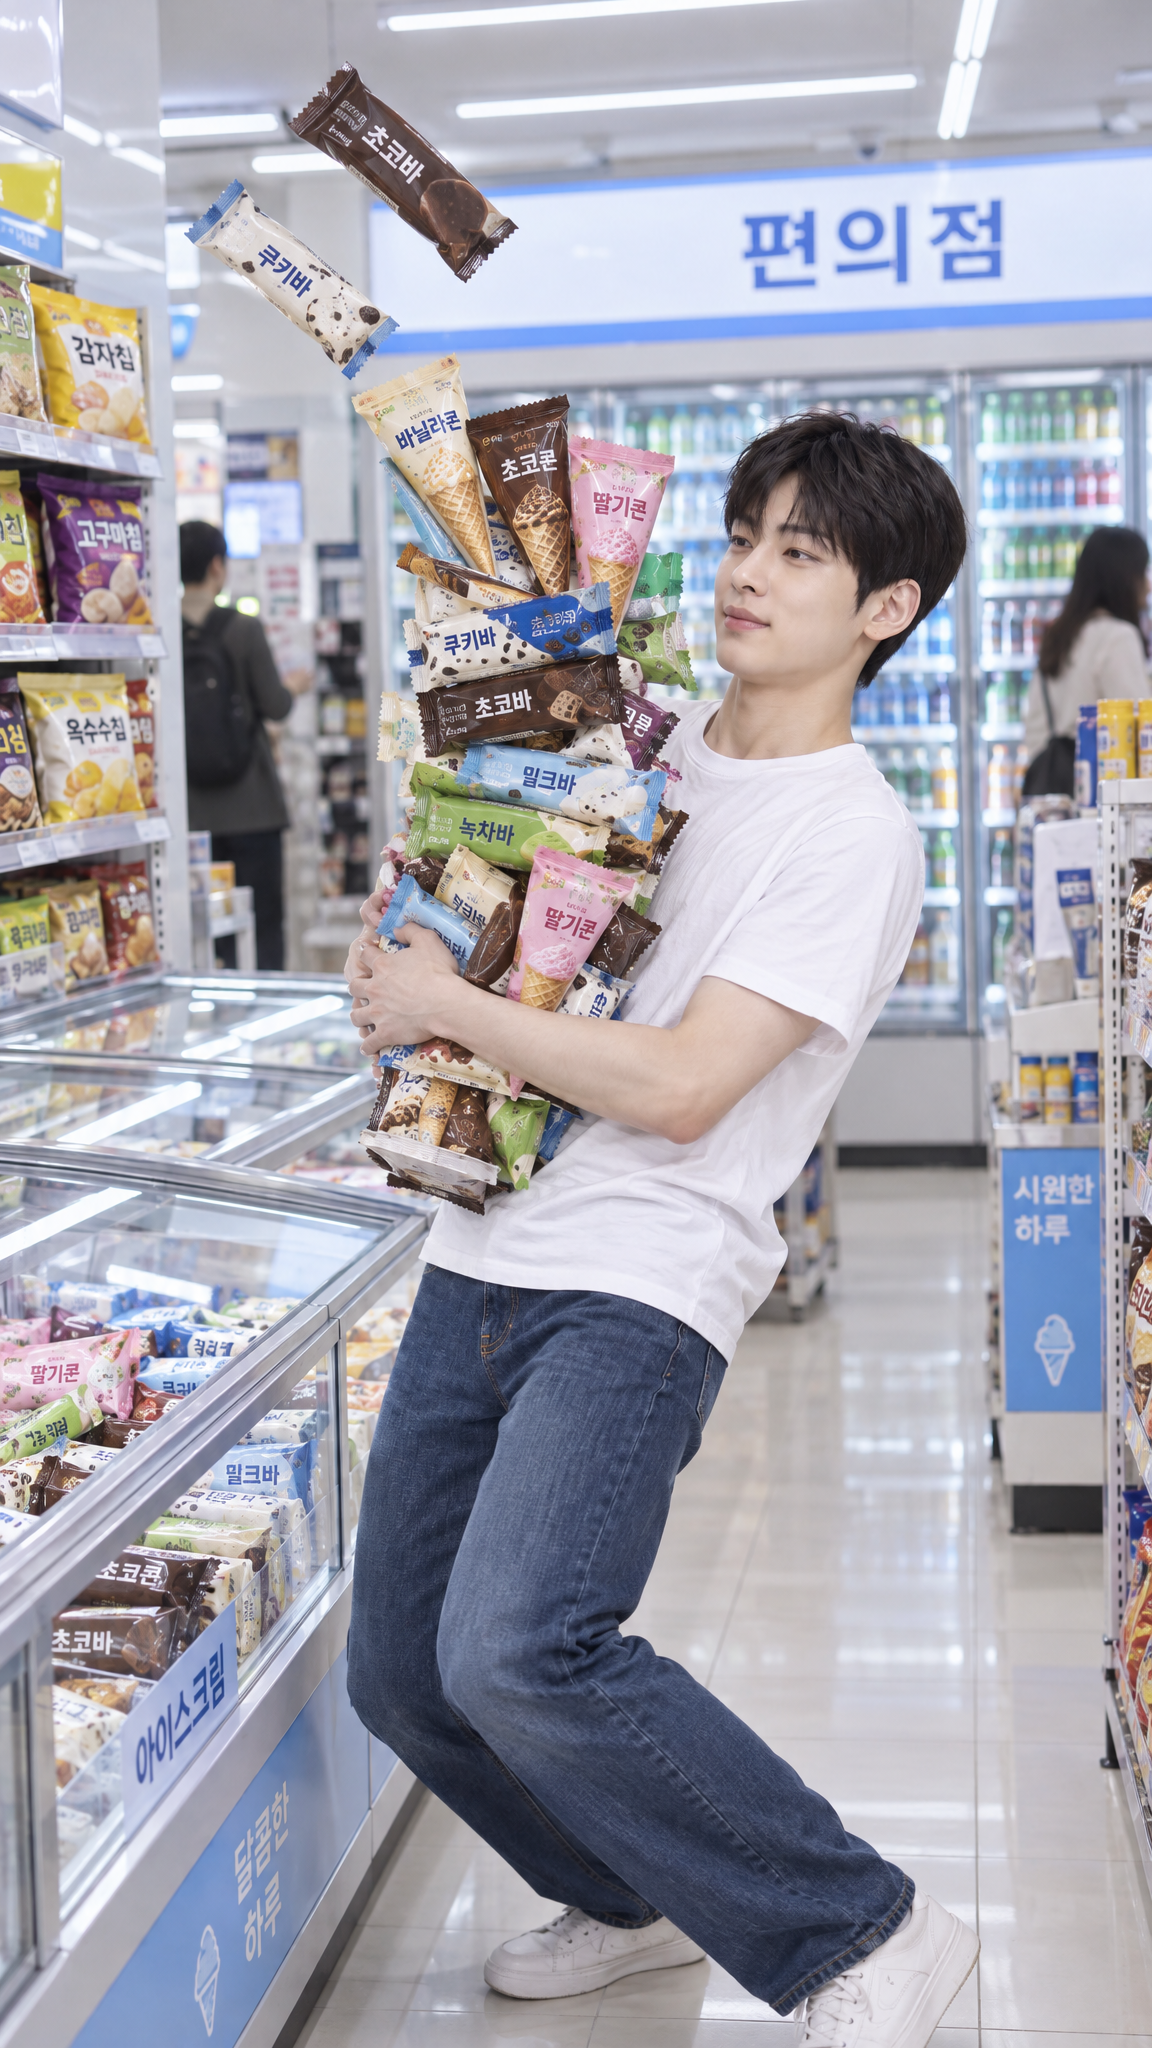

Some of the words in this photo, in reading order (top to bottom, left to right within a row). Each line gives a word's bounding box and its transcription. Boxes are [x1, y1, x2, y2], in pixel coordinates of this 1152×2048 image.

[361, 123, 425, 185] 초코바
[743, 199, 1003, 289] 편의점
[257, 244, 314, 299] 쿠키바
[71, 335, 135, 372] 감자칩
[395, 409, 463, 451] 바닐라콘
[501, 448, 558, 483] 초코콘
[593, 492, 647, 522] 딸기콘
[443, 626, 497, 656] 쿠키바
[474, 689, 532, 720] 초코바
[522, 765, 577, 796] 밀크바
[458, 817, 515, 847] 녹차바
[1013, 1174, 1095, 1206] 시원한
[1014, 1214, 1071, 1246] 하루
[51, 1628, 114, 1655] 초코바
[136, 1643, 226, 1785] 아이스크림
[234, 1780, 290, 1906] 달콤한
[244, 1870, 282, 1963] 하루
